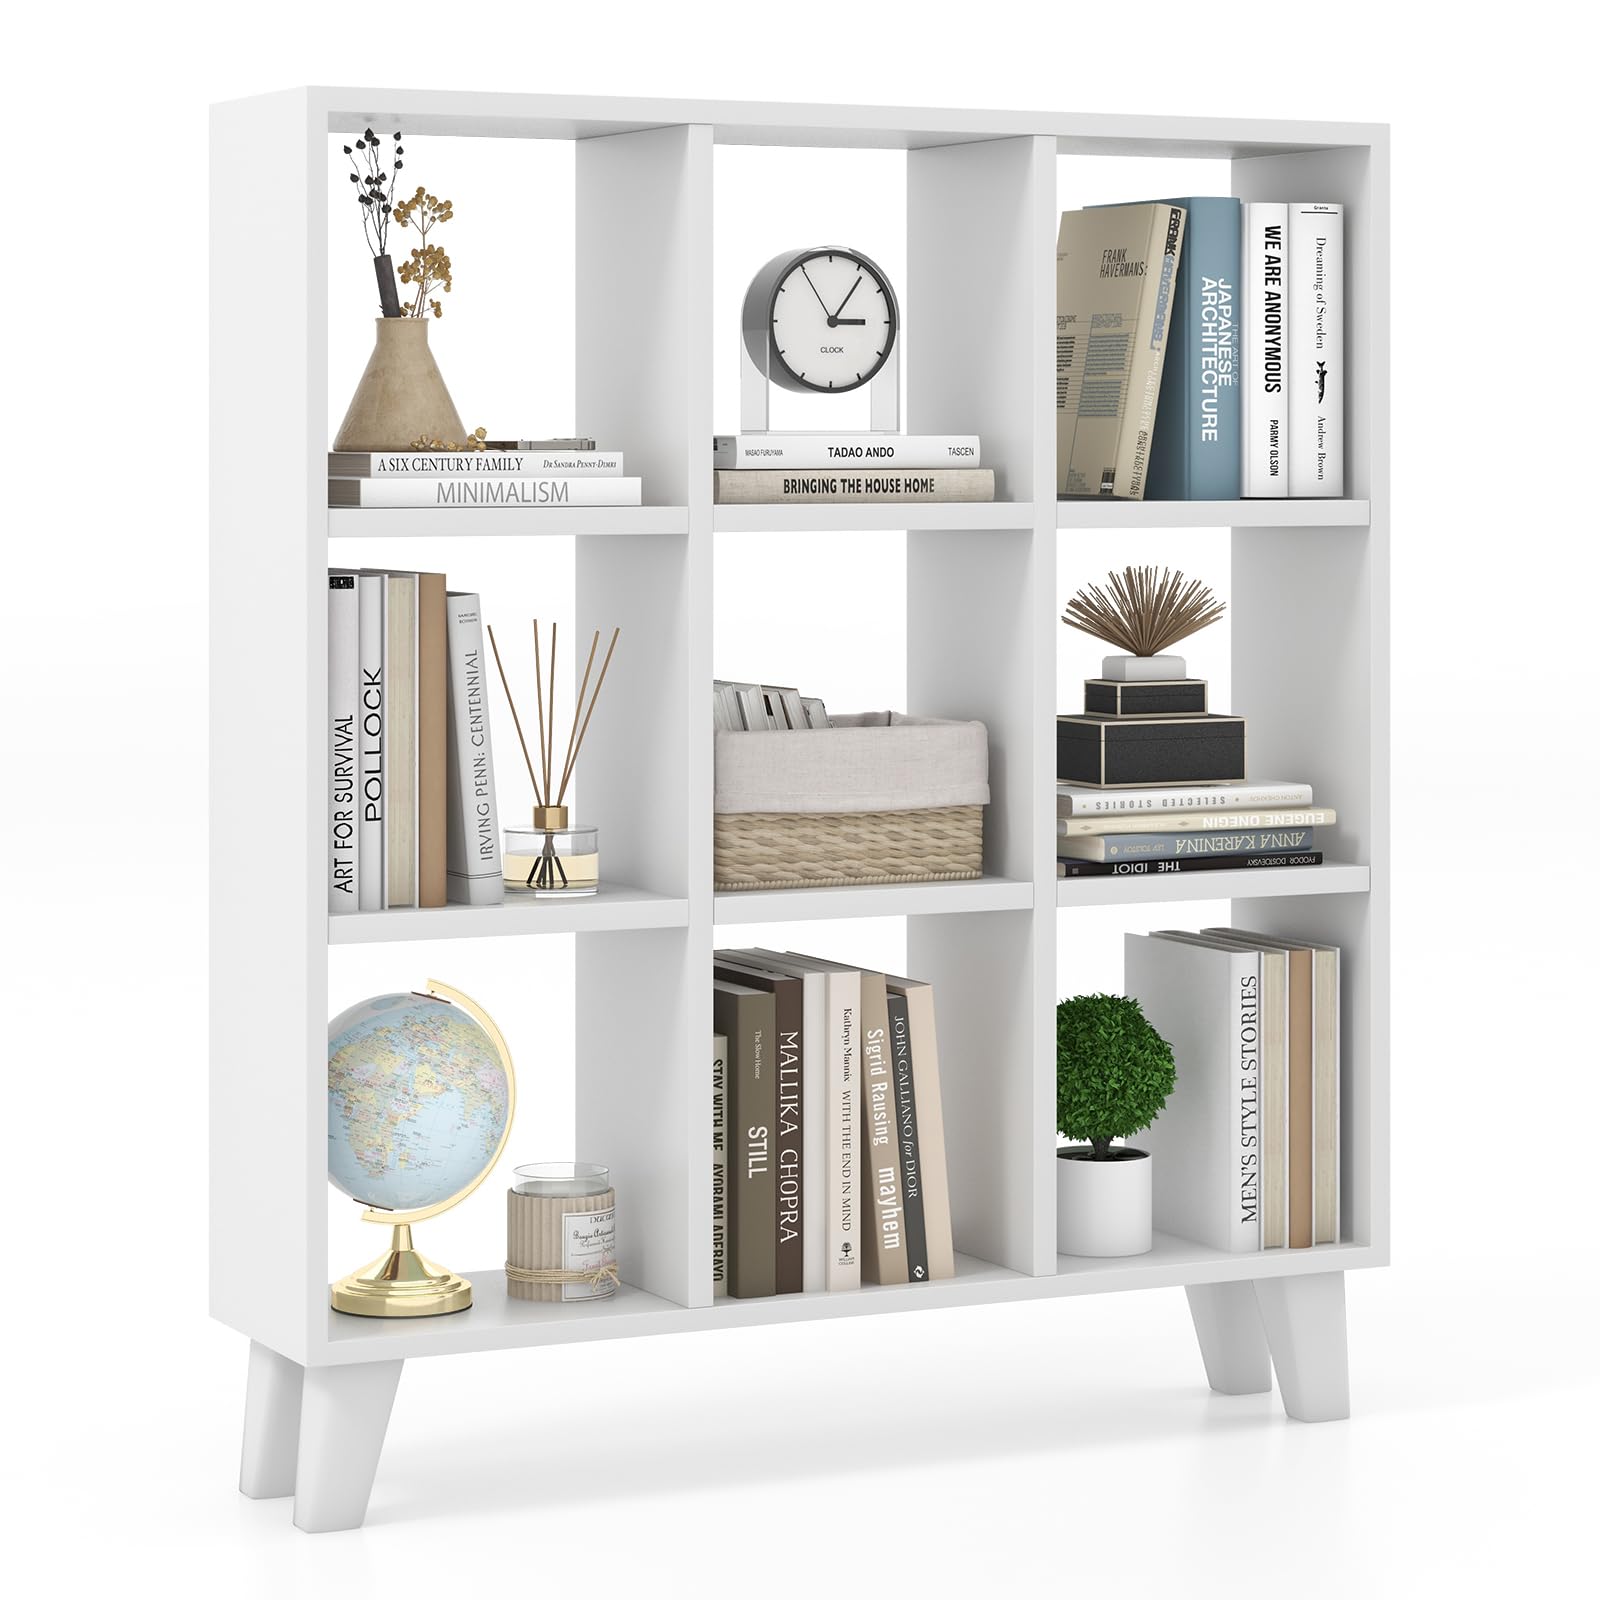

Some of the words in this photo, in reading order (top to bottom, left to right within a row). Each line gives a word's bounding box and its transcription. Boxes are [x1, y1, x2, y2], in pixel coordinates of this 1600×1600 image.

[1165, 208, 1181, 256] FRANK
[1265, 225, 1281, 250] WE
[1100, 262, 1148, 278] HAVERMANS:
[1102, 248, 1127, 263] FRANK
[1265, 254, 1281, 286] ARE
[1313, 238, 1326, 291] Dreaming
[1316, 293, 1326, 305] of
[1218, 278, 1232, 386] JAPANESE
[1265, 291, 1281, 393] ANONYMOUS
[1316, 307, 1327, 349] Sweden
[820, 346, 844, 354] CLOCK
[1201, 277, 1218, 442] ARCHITECTURE
[1232, 371, 1239, 386] OF
[1269, 419, 1279, 448] PARMY
[1317, 415, 1326, 443] Andrew
[378, 458, 386, 472] A
[389, 458, 409, 472] SIX
[411, 457, 473, 472] CENTURY
[476, 457, 524, 472] FAMILY
[827, 447, 863, 458] TADAO
[865, 447, 895, 458] ANDO
[1269, 450, 1279, 477] OLSON
[1317, 444, 1326, 481] Brown
[436, 481, 570, 503] MINIMALISM
[783, 478, 837, 494] BRINGING
[840, 478, 862, 494] THE
[865, 478, 901, 494] HOUSE
[904, 478, 935, 493] HOME
[465, 650, 484, 747] CENTENNIAL
[334, 715, 353, 803] SURVIVAL
[363, 668, 382, 821] POLLOCK
[473, 752, 489, 797] PENN:
[1095, 799, 1152, 810] STORIES
[1162, 796, 1226, 808] SELECTED
[333, 811, 353, 849] FOR
[477, 802, 494, 860] IRVING
[1203, 815, 1260, 828] ONEGIN
[1265, 813, 1325, 826] EUGENE
[1175, 835, 1256, 854] KARENINA
[1260, 832, 1307, 849] ANNA
[333, 858, 353, 893] ART
[1112, 863, 1148, 875] IDIOT
[1157, 861, 1181, 872] THE
[1246, 857, 1286, 866] DOSTOEVSKY
[1289, 856, 1316, 864] FYODOR
[842, 1008, 852, 1046] Kathryn
[894, 1016, 907, 1056] JOHN
[1241, 975, 1257, 1071] STORIES
[843, 1048, 852, 1082] Mannix
[865, 1028, 887, 1076] Sigrid
[780, 1031, 799, 1136] MALLIKA
[898, 1059, 913, 1137] GALLIANO
[713, 1093, 723, 1127] WITH
[842, 1090, 851, 1121] WITH
[871, 1081, 891, 1146] Rausing
[1241, 1076, 1257, 1147] STYLE
[748, 1126, 768, 1179] STILL
[842, 1125, 851, 1149] THE
[903, 1140, 914, 1157] for
[842, 1153, 851, 1178] END
[905, 1160, 918, 1198] DIOR
[780, 1149, 799, 1243] CHOPRA
[842, 1181, 851, 1194] IN
[1241, 1154, 1257, 1224] MEN'S
[842, 1198, 851, 1231] MIND
[877, 1167, 902, 1249] mayhem
